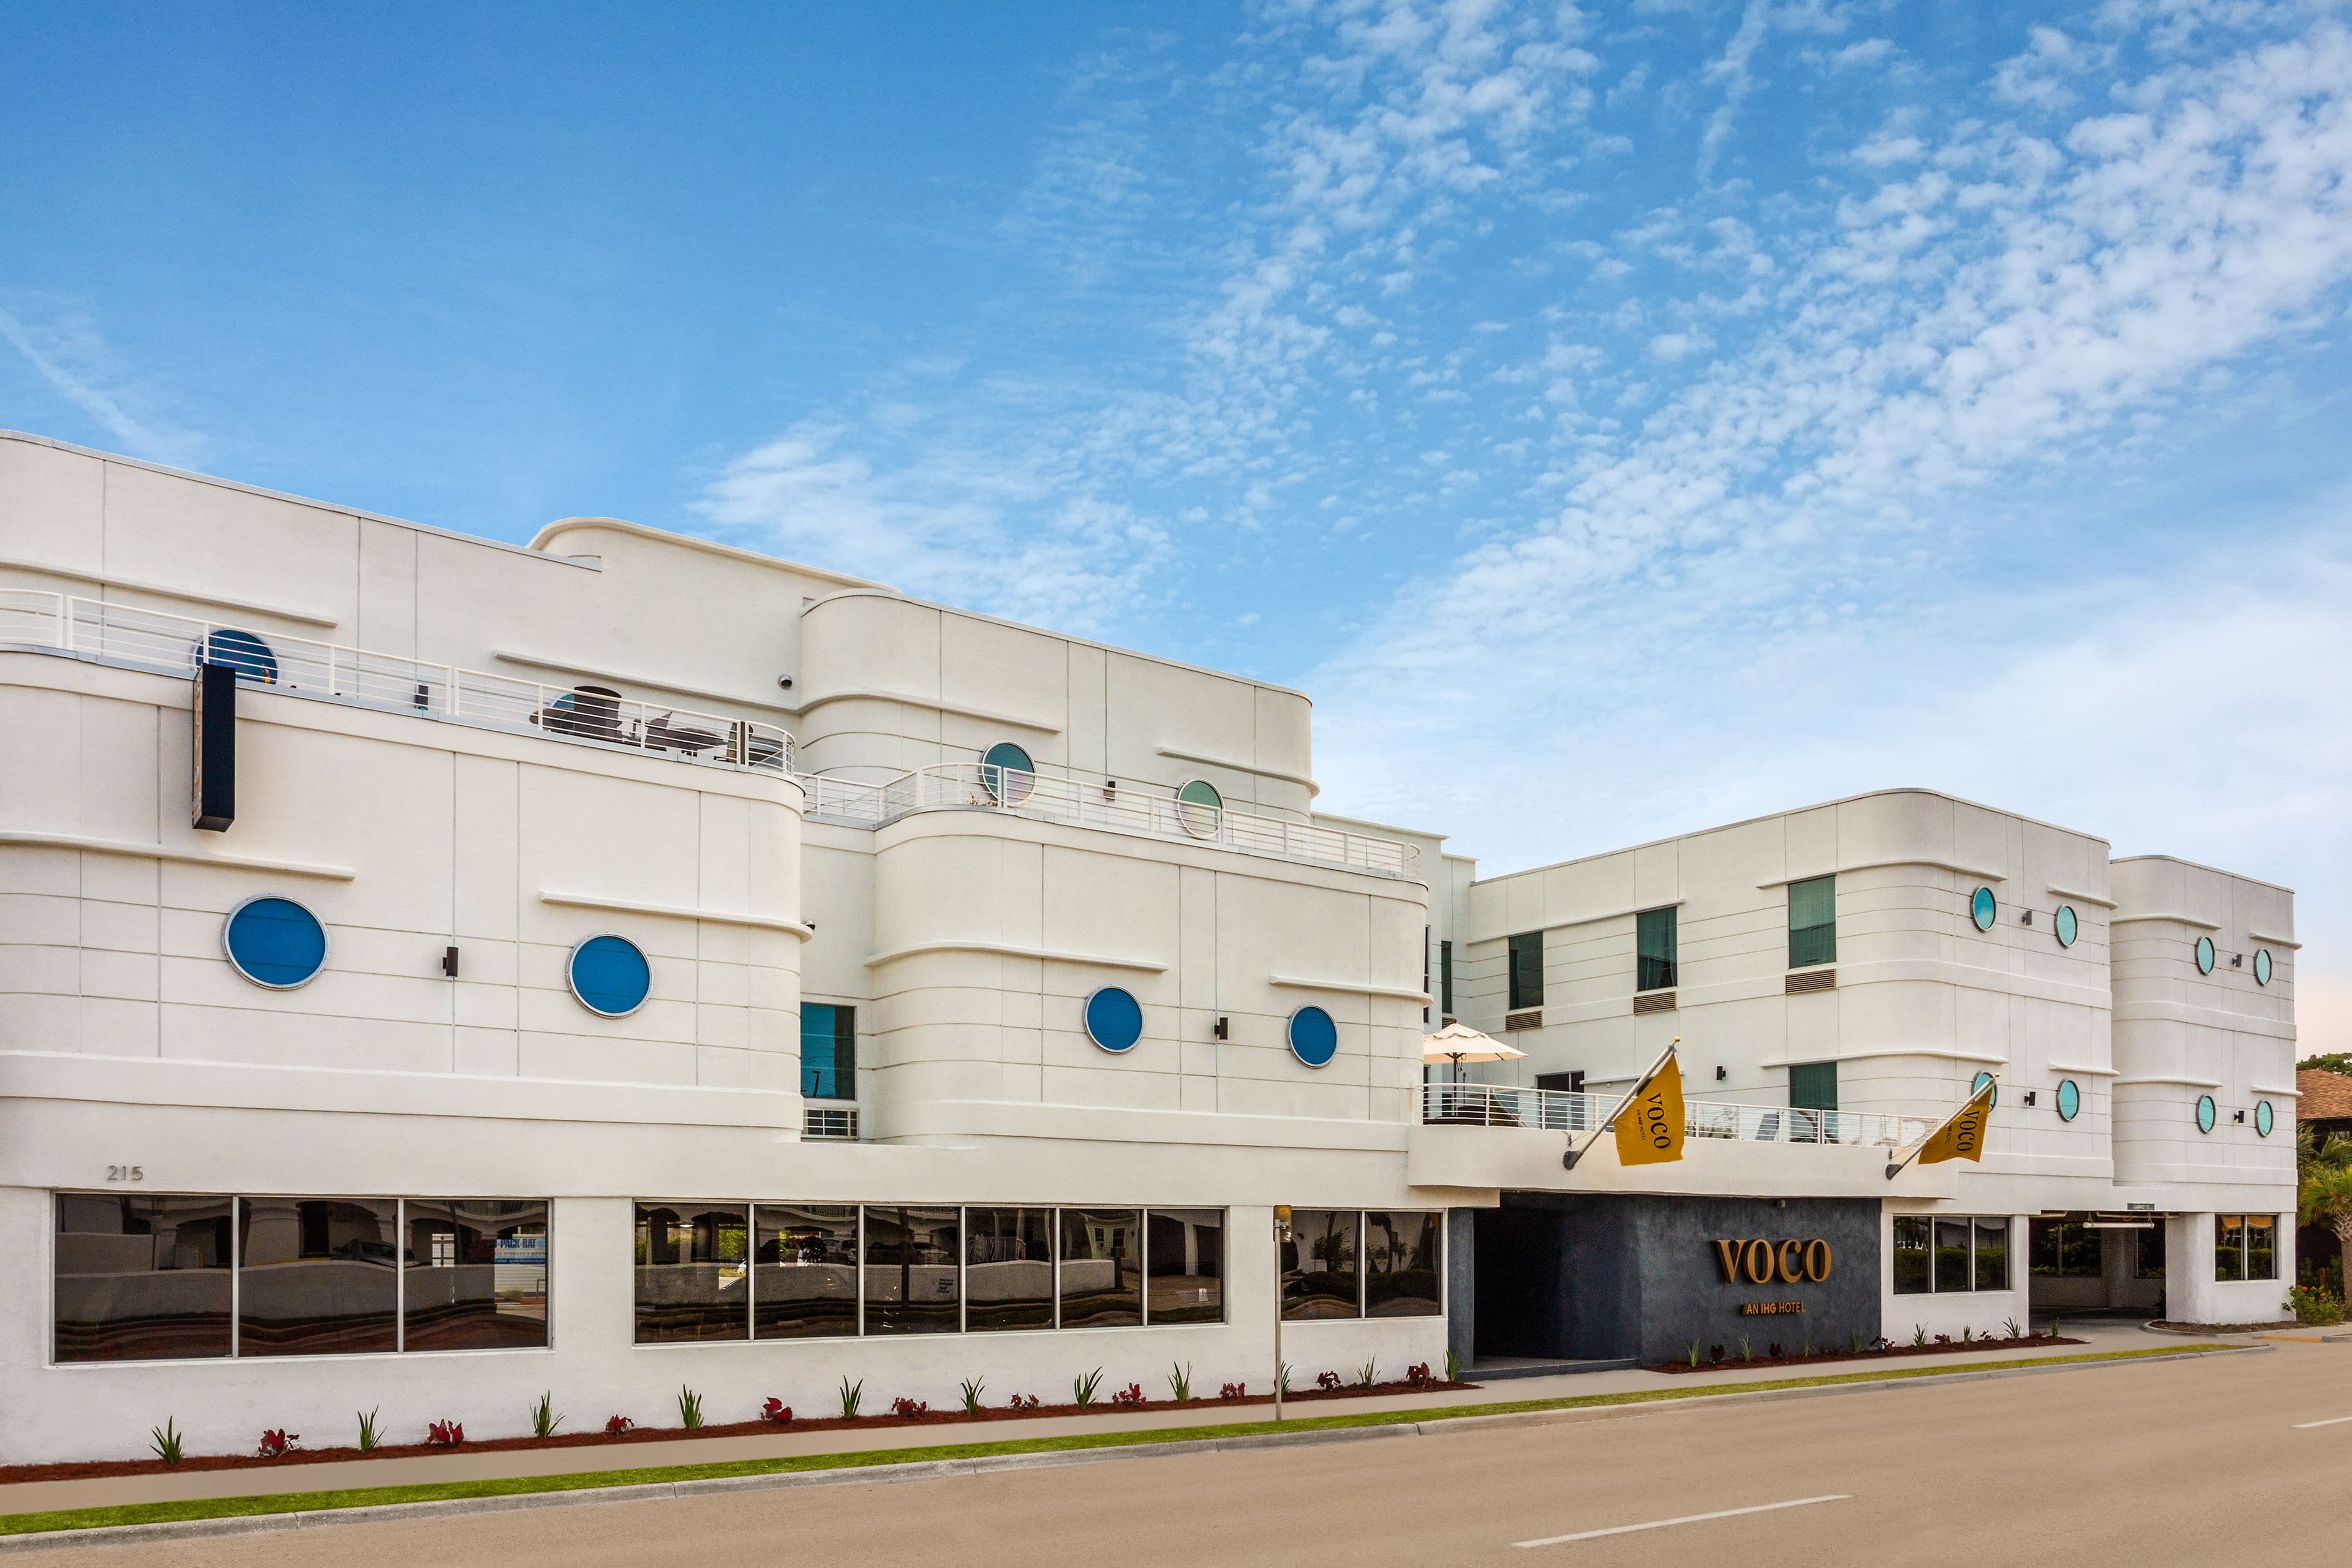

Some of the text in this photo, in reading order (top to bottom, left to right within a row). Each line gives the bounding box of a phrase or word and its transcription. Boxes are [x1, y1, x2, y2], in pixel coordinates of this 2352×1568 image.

[1646, 1091, 1671, 1149] VOCO
[1956, 1110, 1980, 1152] VOCO
[108, 1166, 143, 1181] 215
[1716, 1238, 1832, 1284] VOCO
[1745, 1302, 1806, 1315] AN IHG HOTEL
